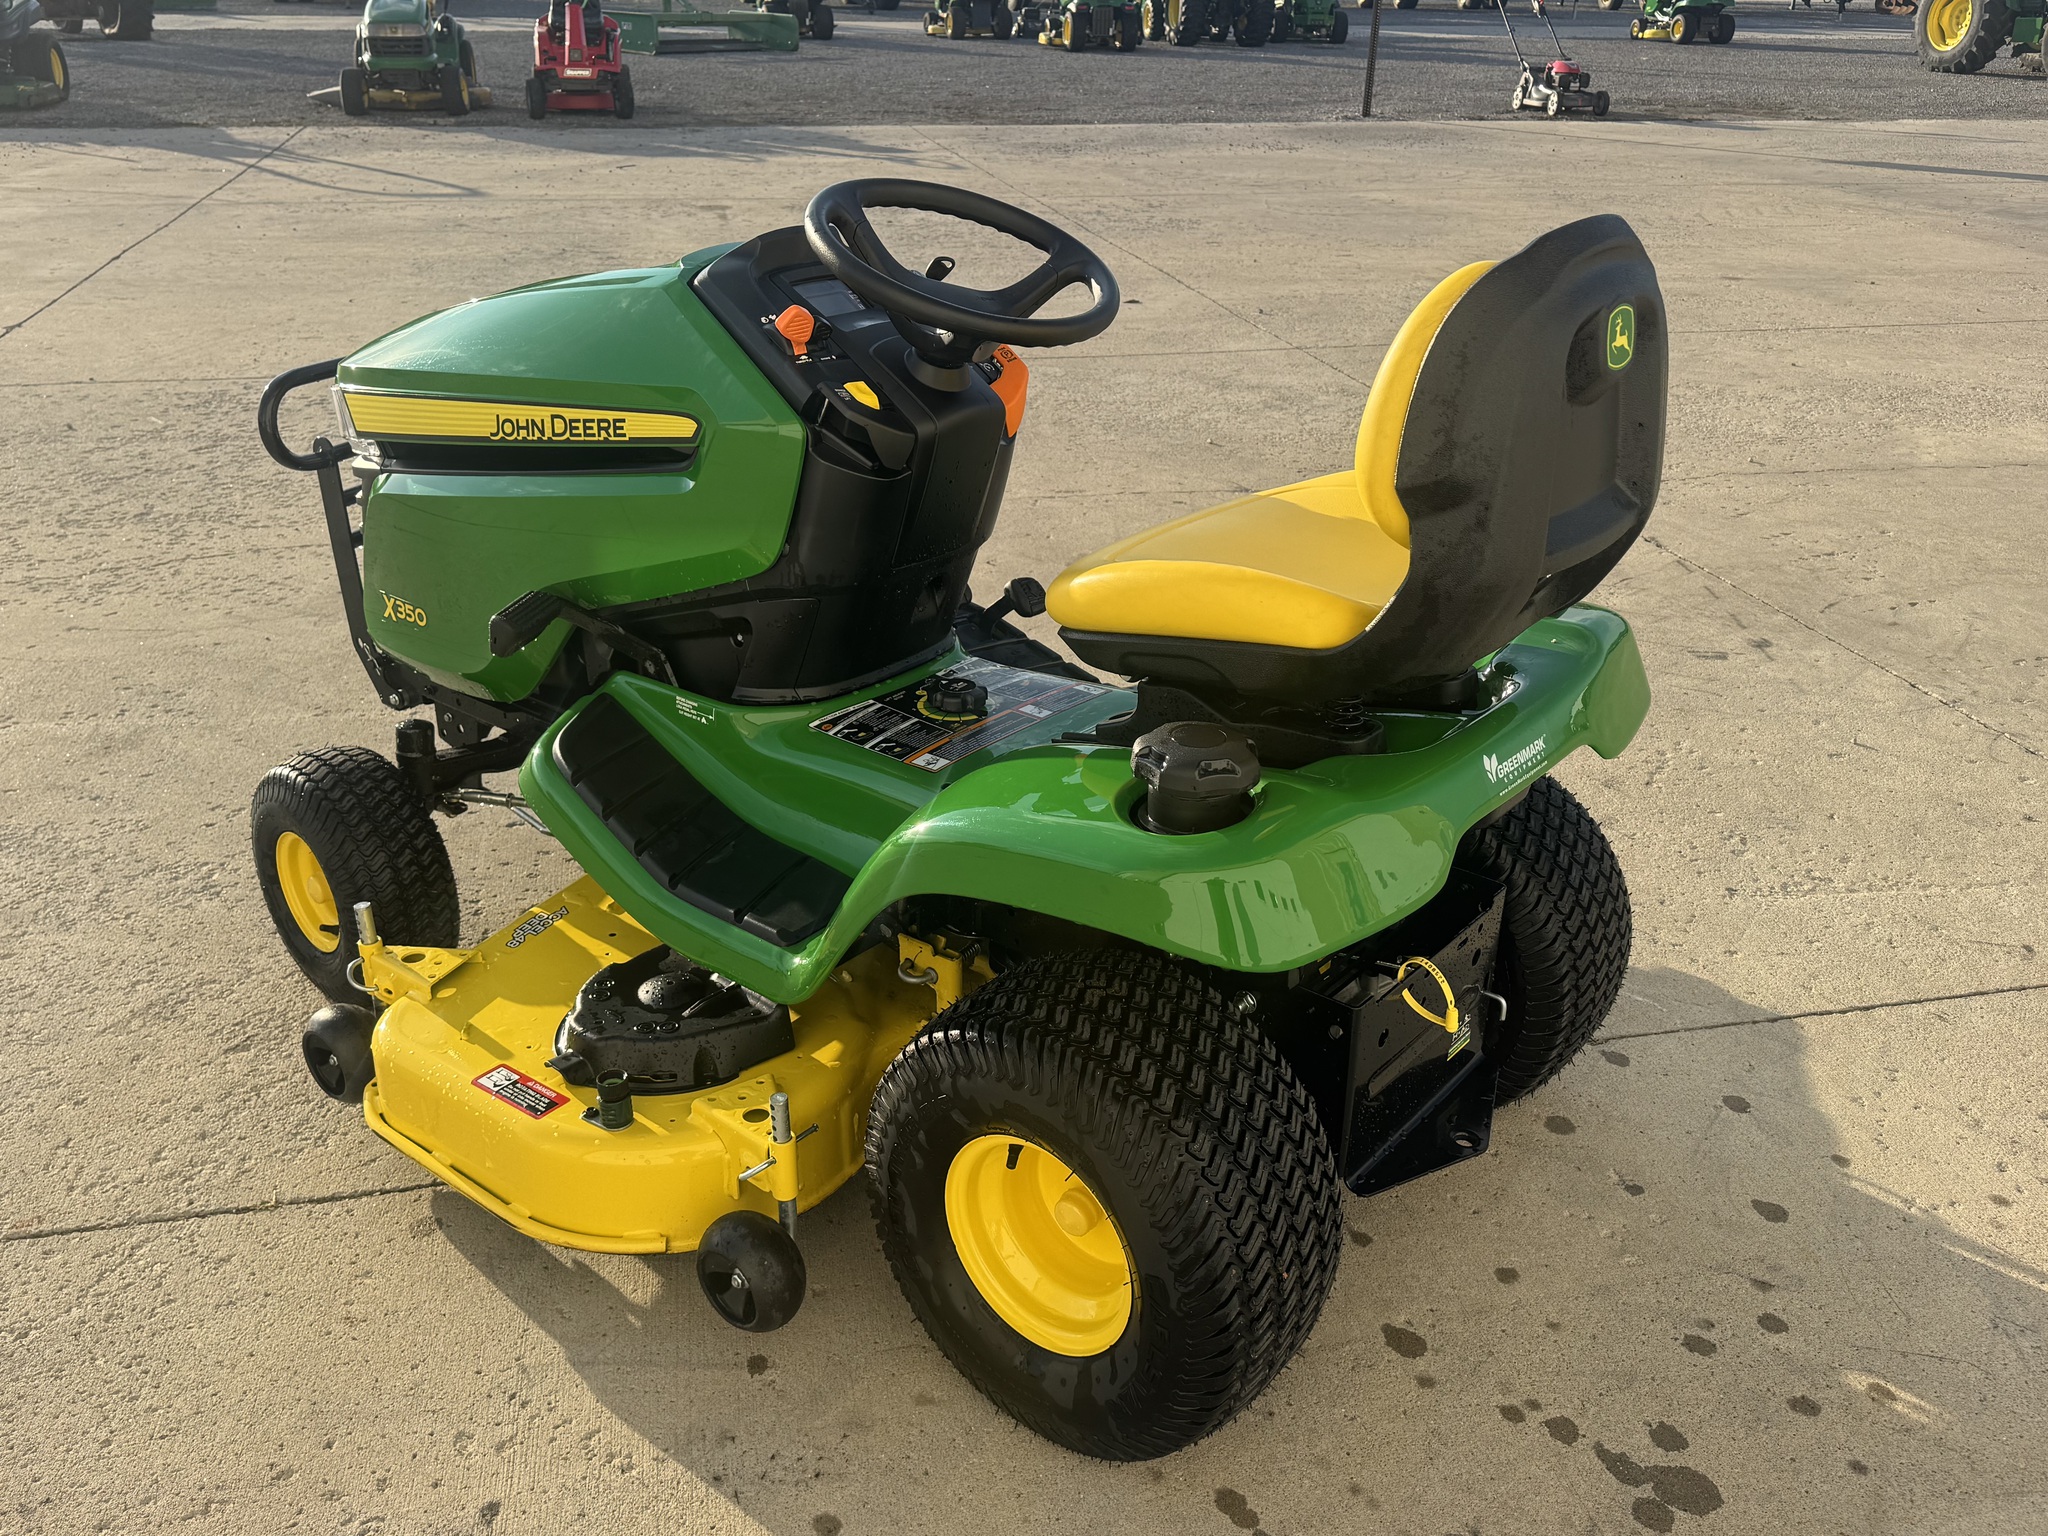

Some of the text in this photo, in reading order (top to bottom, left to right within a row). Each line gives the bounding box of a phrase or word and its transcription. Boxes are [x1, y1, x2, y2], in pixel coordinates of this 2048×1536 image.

[490, 414, 627, 438] JOHN DEERE
[382, 593, 427, 627] X350
[1497, 735, 1546, 778] GREENMARK
[512, 912, 549, 938] DEEP
[523, 905, 569, 936] ACCEL
[505, 935, 525, 949] 48
[533, 1083, 558, 1098] DANGER
